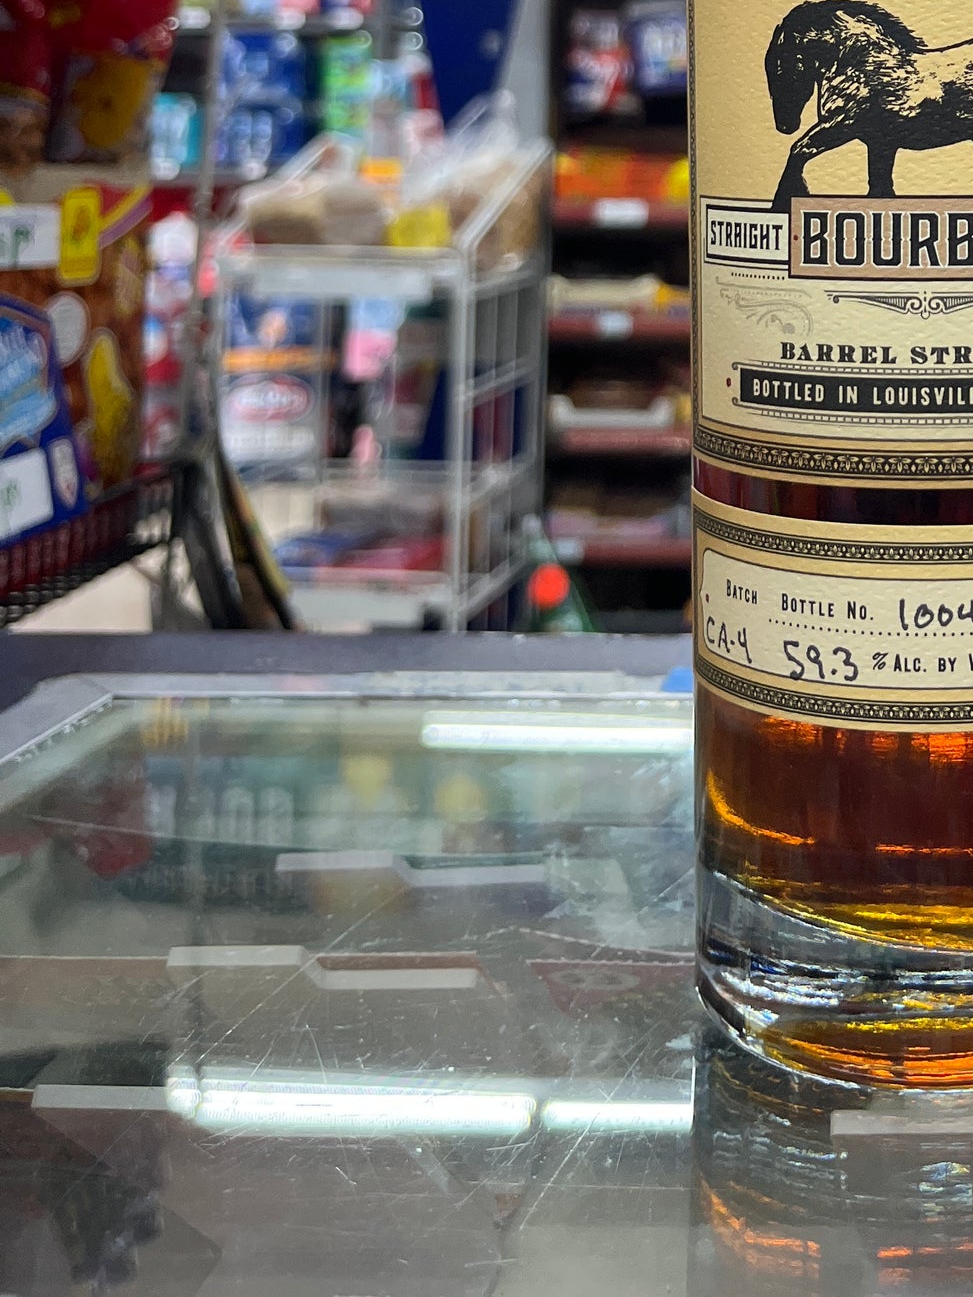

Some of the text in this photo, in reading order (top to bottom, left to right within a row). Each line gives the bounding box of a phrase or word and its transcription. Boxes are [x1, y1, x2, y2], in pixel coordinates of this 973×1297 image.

[709, 219, 784, 252] STRAIGHT
[779, 341, 898, 365] BARREL
[752, 378, 826, 403] BOTTLED
[838, 387, 860, 405] IN
[725, 579, 759, 606] BATCH
[780, 592, 836, 620] BOTTLE
[782, 639, 860, 682] 59.3
